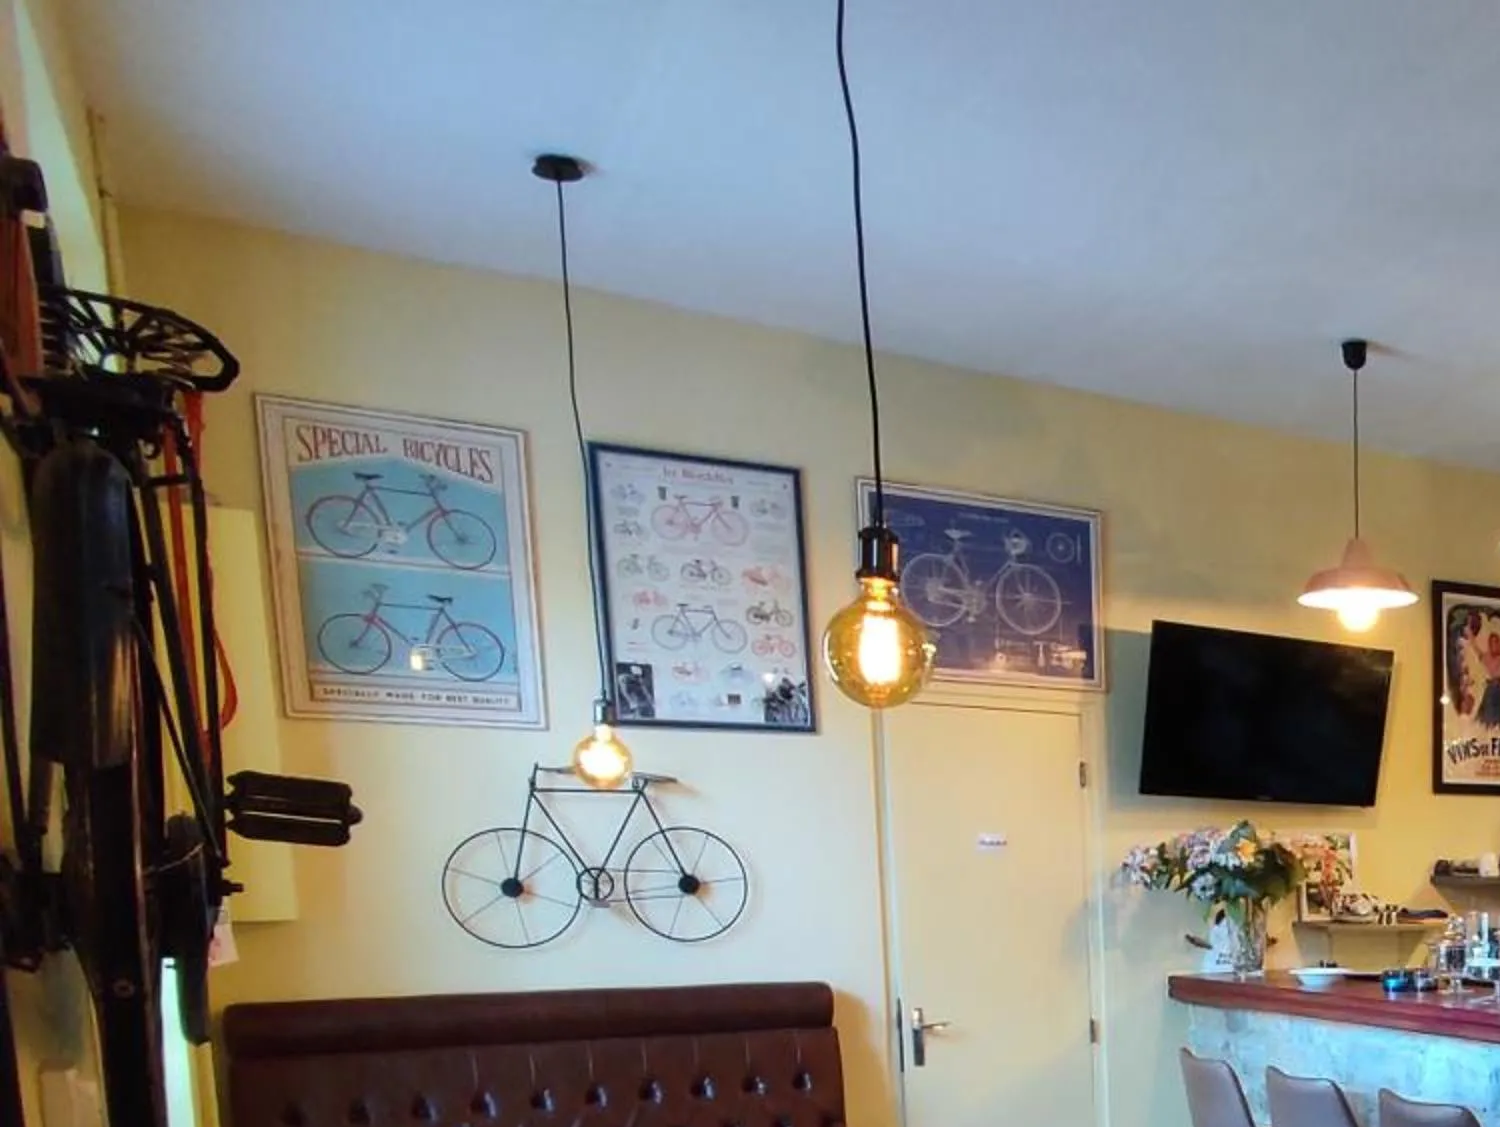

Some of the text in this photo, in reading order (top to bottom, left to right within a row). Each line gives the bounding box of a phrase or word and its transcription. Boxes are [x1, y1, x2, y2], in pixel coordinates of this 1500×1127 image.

[295, 424, 495, 484] SPECIAL BICYCLES
[1447, 737, 1480, 765] VINS
